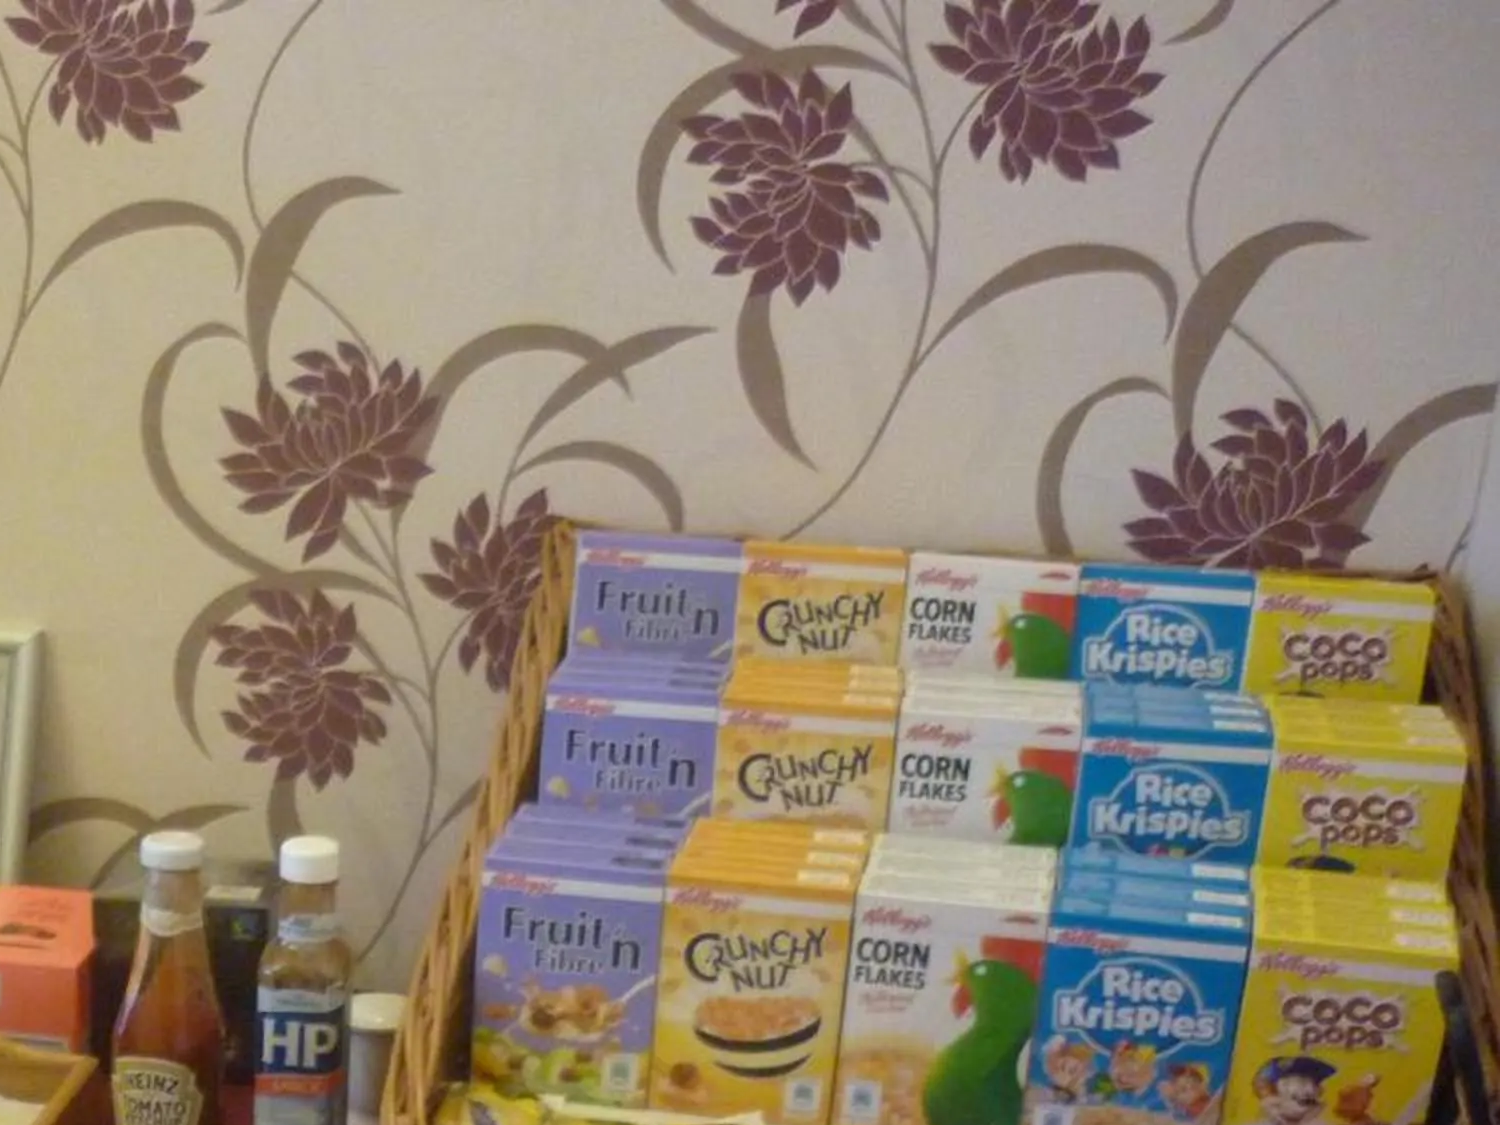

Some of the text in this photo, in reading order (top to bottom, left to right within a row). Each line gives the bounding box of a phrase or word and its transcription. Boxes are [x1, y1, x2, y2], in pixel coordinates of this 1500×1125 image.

[596, 581, 688, 617] Fruit
[909, 598, 976, 625] CORN
[757, 591, 885, 647] CRUNCHY
[908, 623, 973, 645] FLAKES
[1126, 612, 1198, 647] Rice
[797, 624, 857, 655] NUT
[1087, 642, 1233, 680] Krispies
[1301, 661, 1374, 688] pops
[565, 729, 662, 768] Fruit
[737, 743, 874, 802] CRUNCHY
[901, 753, 971, 780] CORN
[782, 780, 845, 812] NUT
[900, 779, 967, 802] FLAKES
[1135, 773, 1213, 808] Rice
[1094, 801, 1246, 840] Krispies
[1320, 823, 1401, 850] pops
[503, 906, 603, 949] Fruit
[684, 926, 828, 983] CRUNCHY
[857, 938, 931, 968] CORN
[730, 961, 799, 992] NUT
[855, 965, 926, 991] FLAKES
[1103, 966, 1184, 1003] Rice
[1058, 997, 1217, 1040] Krispies
[262, 1017, 338, 1069] HP
[1302, 1026, 1385, 1051] pops
[125, 1072, 180, 1096] HEINZ
[123, 1094, 186, 1117] TOMATO
